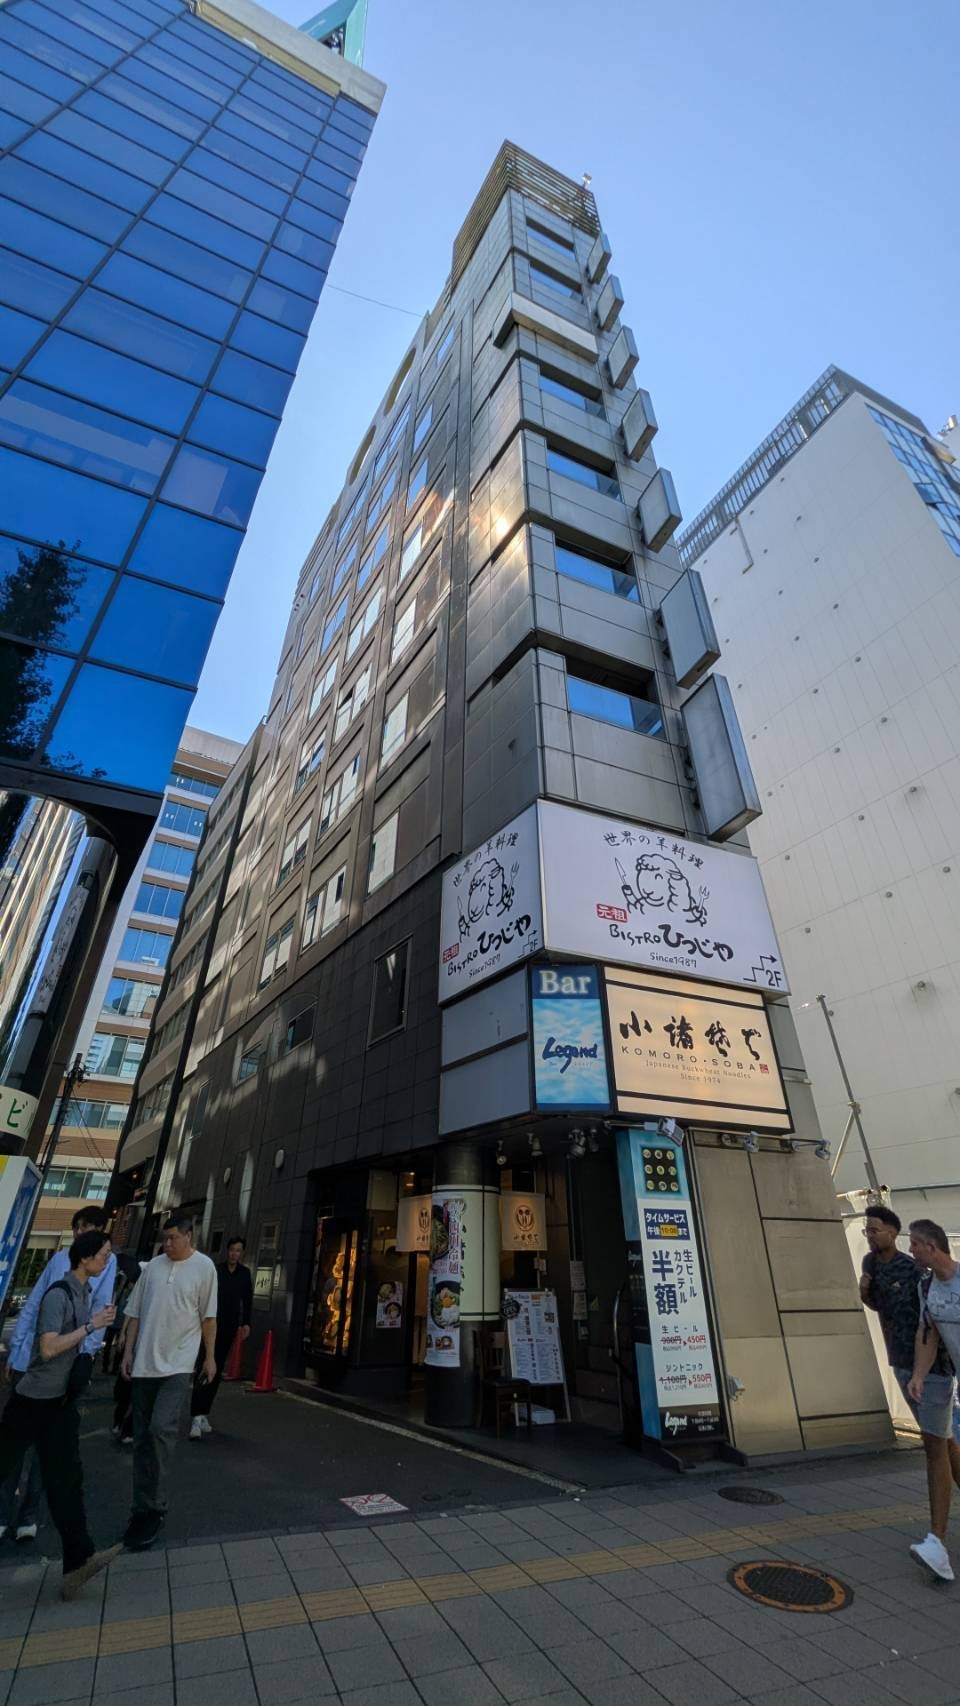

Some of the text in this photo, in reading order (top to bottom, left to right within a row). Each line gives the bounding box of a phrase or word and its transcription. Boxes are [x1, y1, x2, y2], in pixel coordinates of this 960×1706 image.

[453, 832, 519, 888] 世界の羊料理
[603, 831, 704, 869] 世界の羊料理
[597, 905, 628, 922] 元祖
[478, 914, 531, 954] ひつじや
[658, 924, 734, 962] ひつじや
[539, 970, 591, 994] Bar
[766, 970, 782, 987] 2F
[542, 1036, 598, 1074] Legend
[645, 1059, 752, 1079] Japanese Buckwheat Noodles
[680, 1073, 700, 1082] Since
[645, 1212, 686, 1224] タイムサービス
[652, 1250, 680, 1315] 半額
[674, 1250, 687, 1304] カクテル
[683, 1249, 697, 1298] 生ビール
